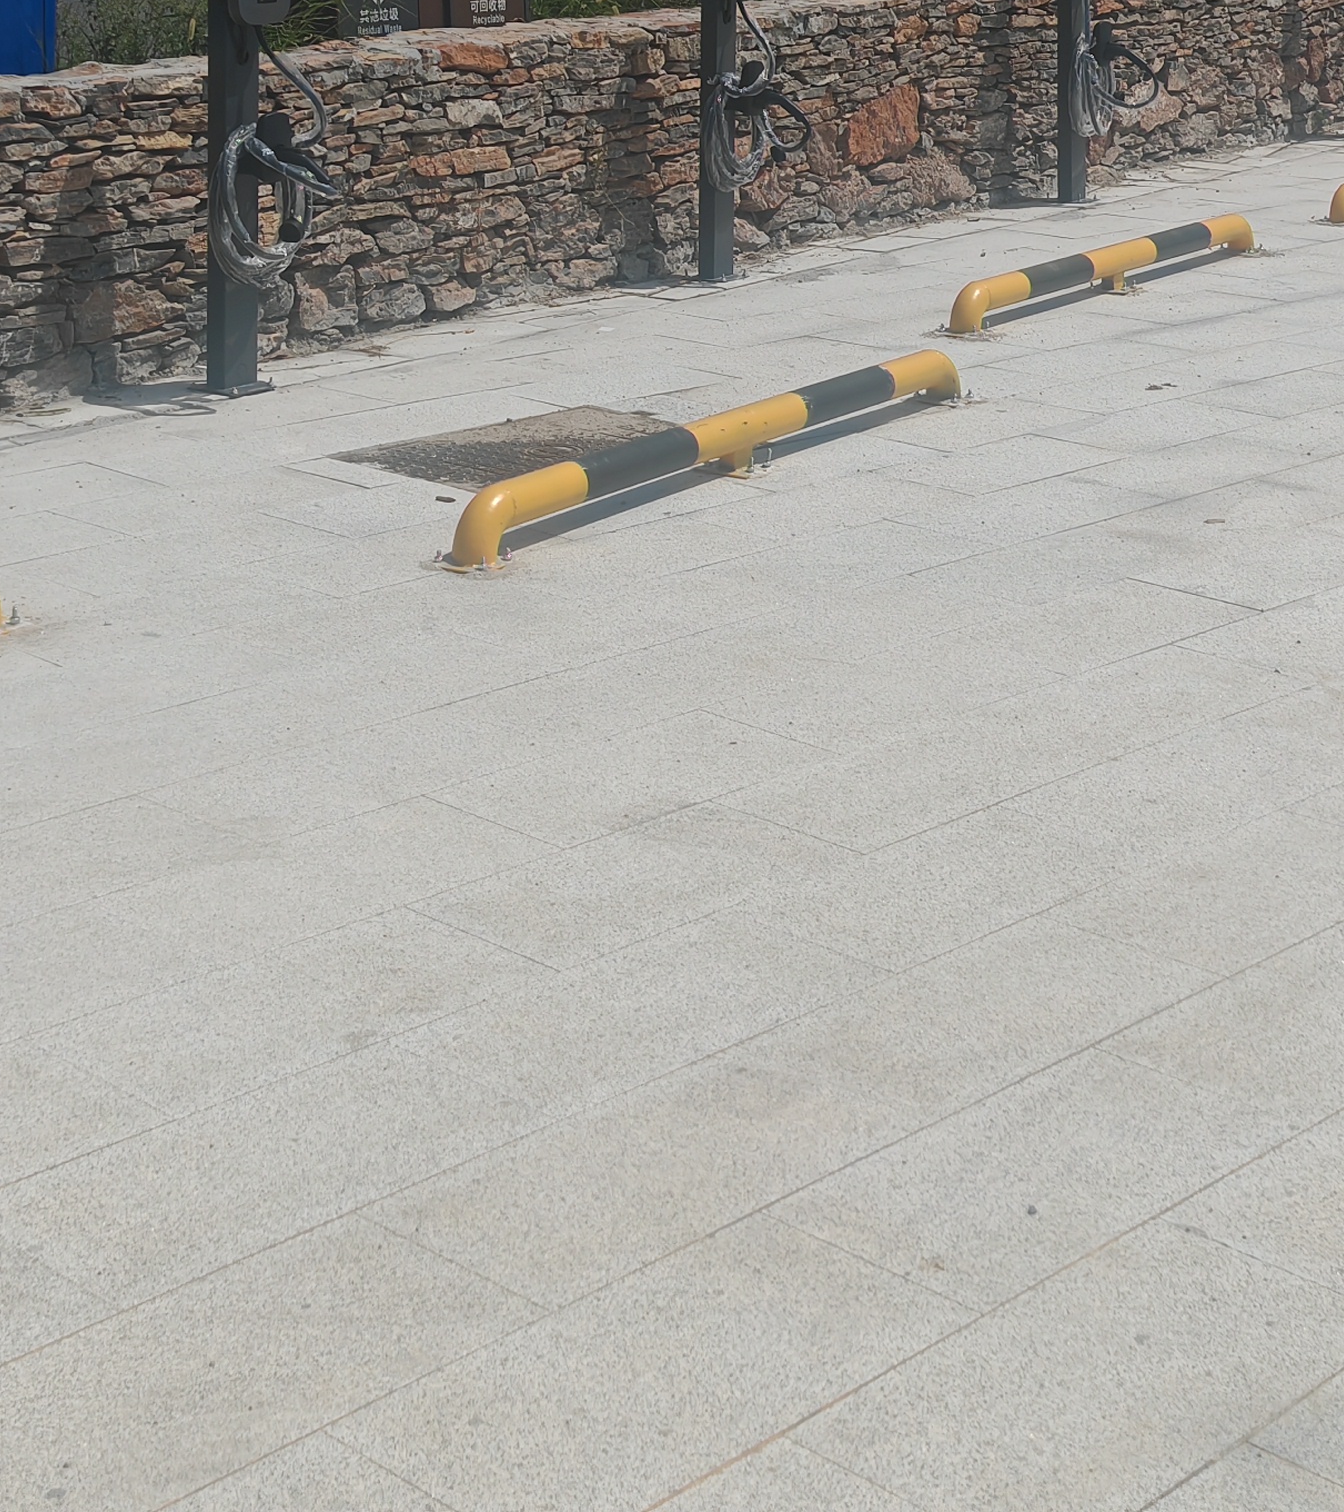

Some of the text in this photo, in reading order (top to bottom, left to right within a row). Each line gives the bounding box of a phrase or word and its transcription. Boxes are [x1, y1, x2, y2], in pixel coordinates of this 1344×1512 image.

[359, 7, 399, 23] 其他垃圾
[472, 14, 506, 26] Recyclable
[357, 25, 383, 35] Residual
